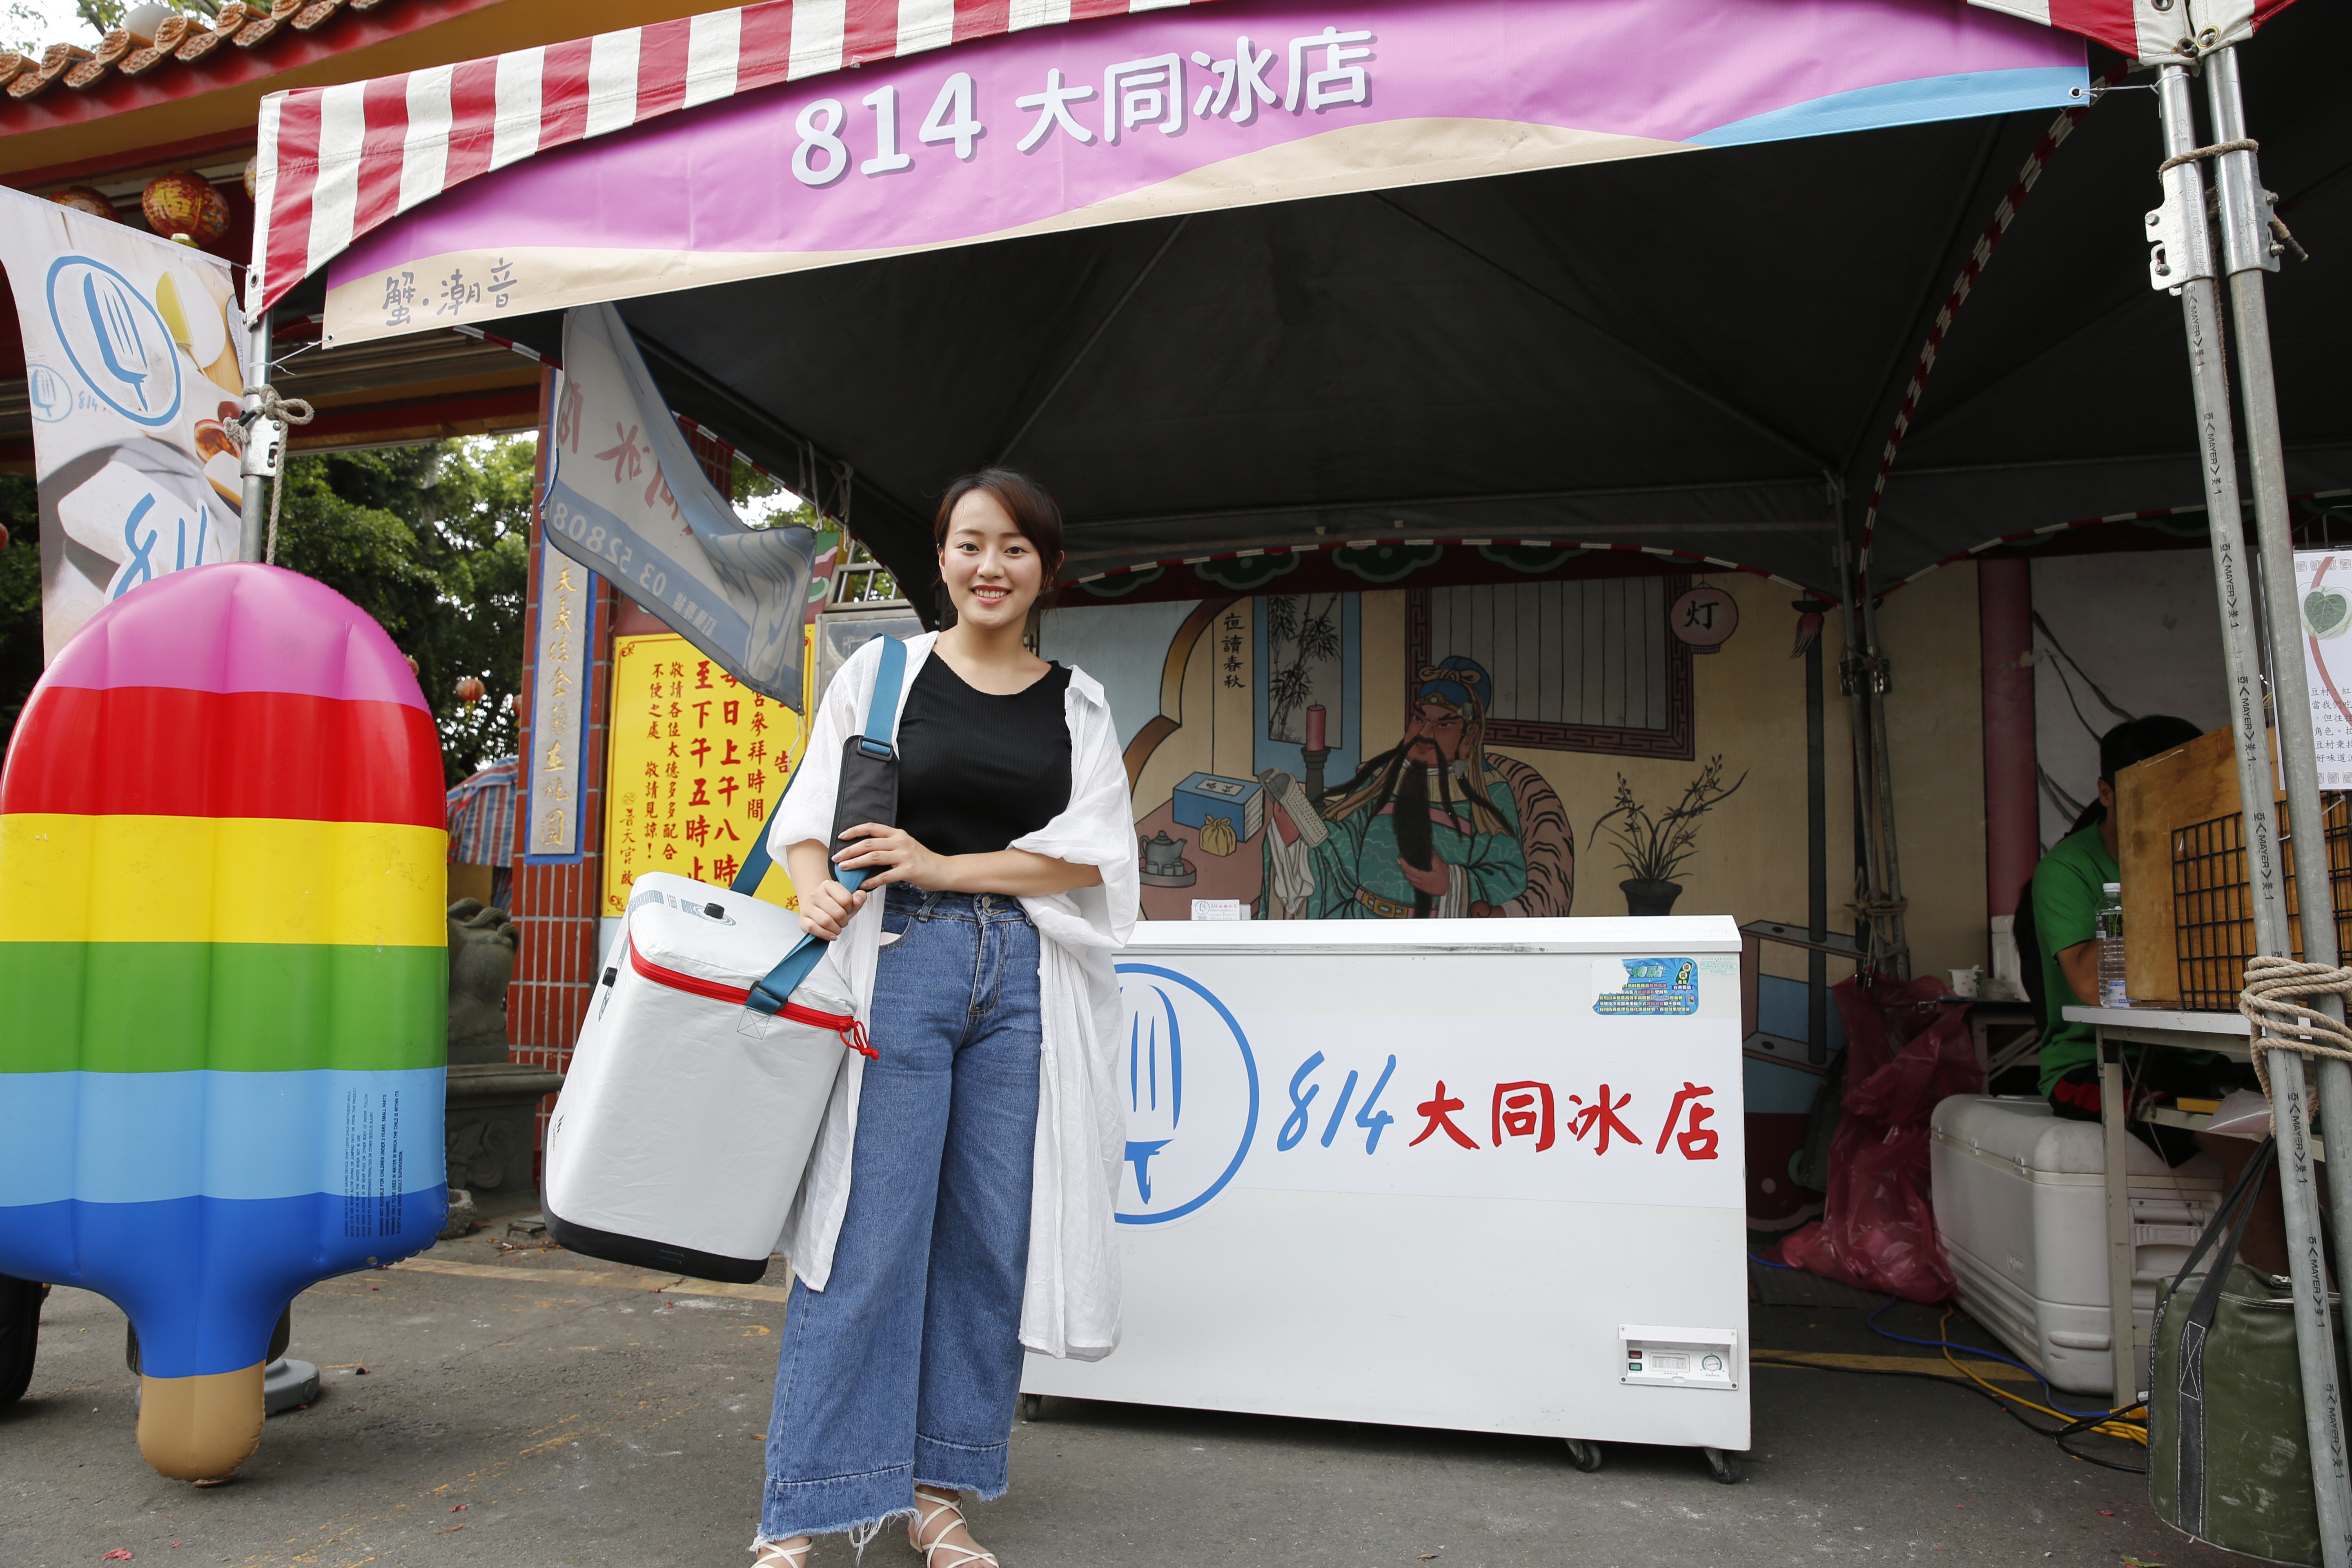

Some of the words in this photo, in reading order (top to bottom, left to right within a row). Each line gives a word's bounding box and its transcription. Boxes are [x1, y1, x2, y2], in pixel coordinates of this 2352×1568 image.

[791, 71, 985, 186] 814
[1016, 26, 1374, 153] 大同冰店
[78, 390, 98, 412] 814
[1682, 600, 1720, 629] 灯
[646, 664, 664, 739] 不便之處
[662, 662, 684, 860] 敬請各位大德多多配合
[686, 660, 713, 884] 至下午五時止
[1277, 1050, 1396, 1155] 814
[1408, 1080, 1719, 1160] 大同冰店
